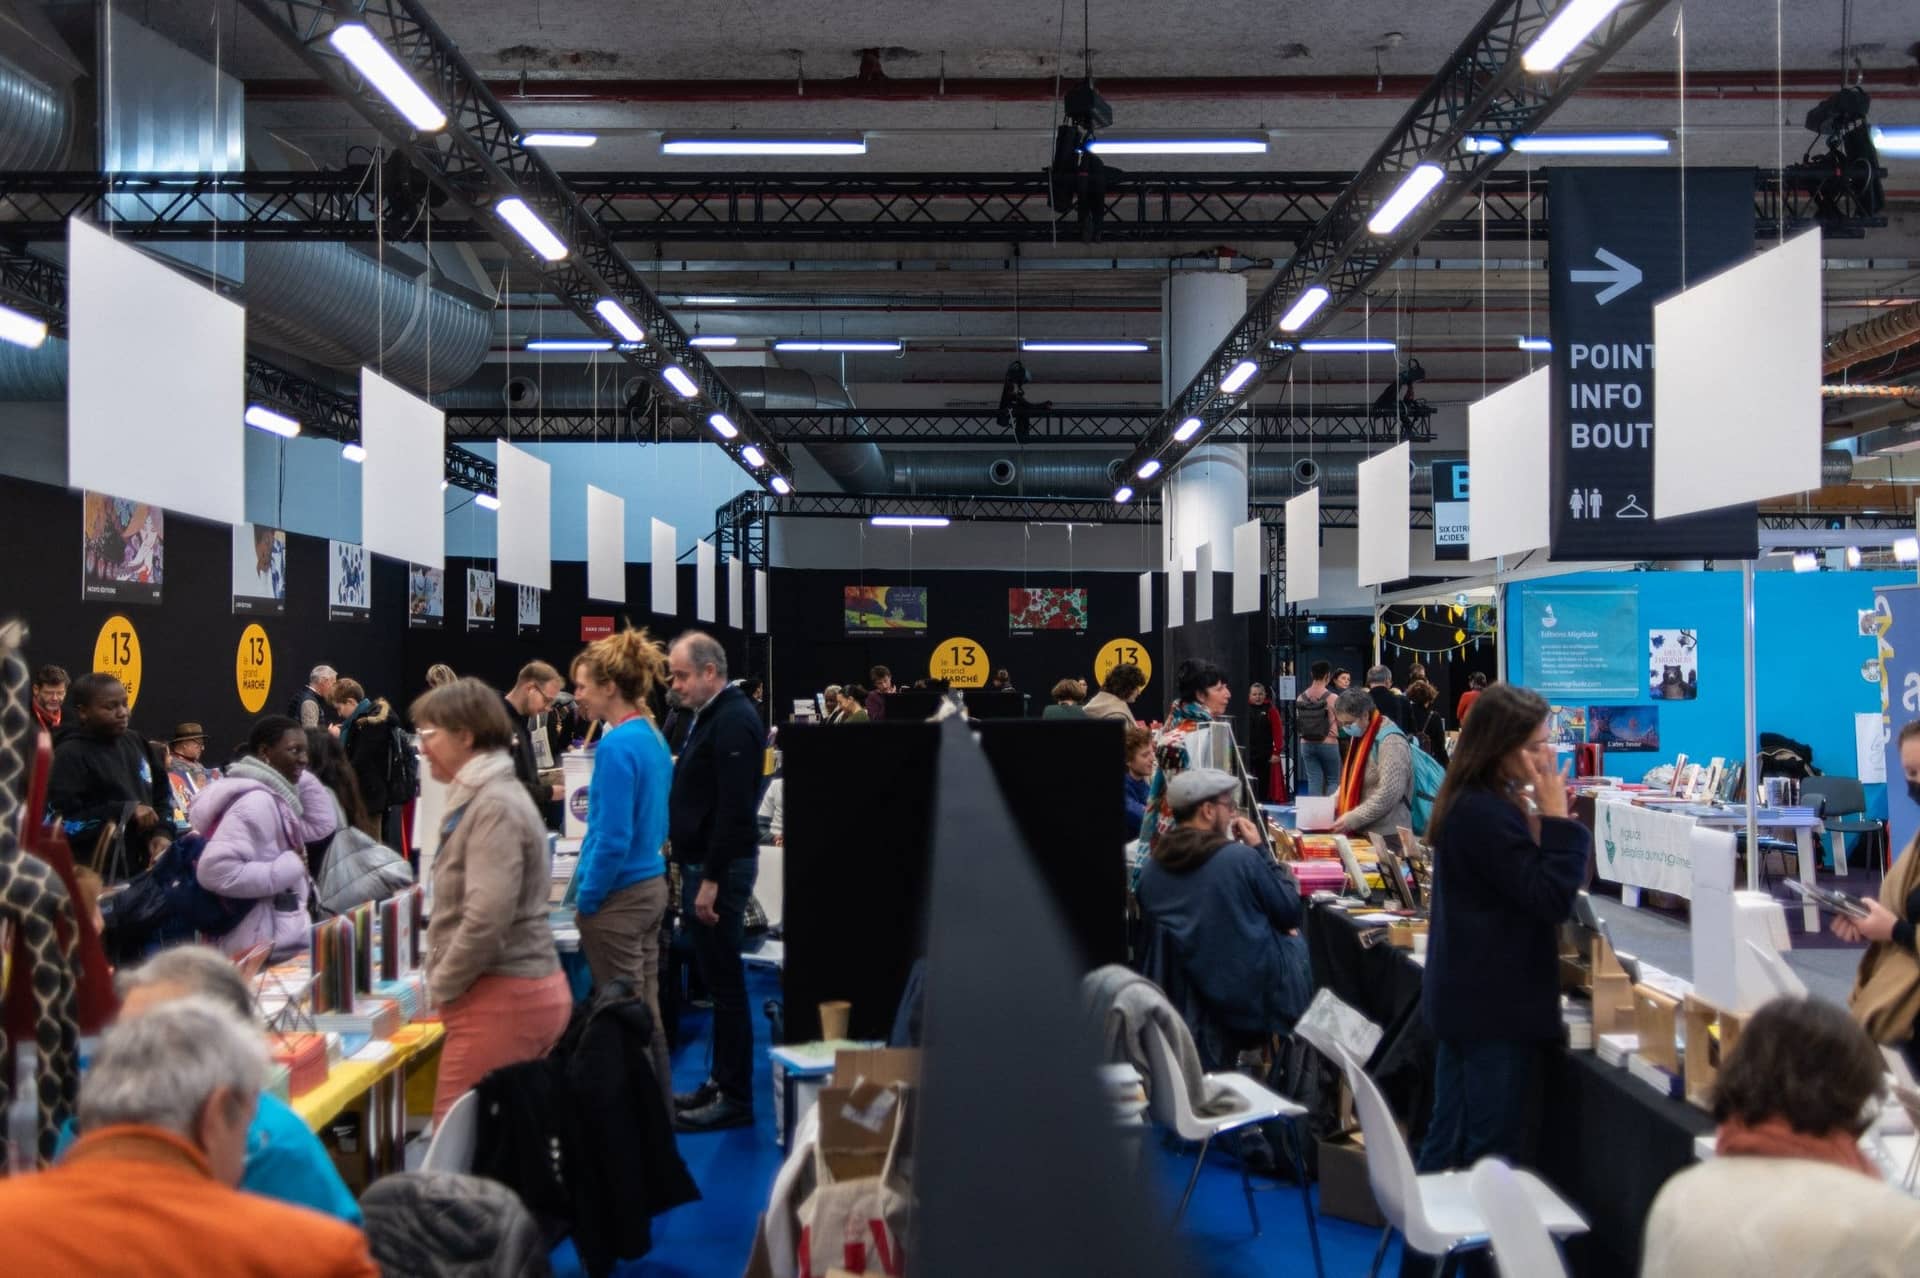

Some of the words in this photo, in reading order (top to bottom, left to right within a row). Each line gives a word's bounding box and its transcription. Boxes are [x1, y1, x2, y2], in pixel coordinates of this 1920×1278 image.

[1571, 344, 1656, 369] POINT
[1571, 384, 1642, 409] INFO
[1451, 525, 1469, 533] CITR
[111, 632, 131, 665] 13
[250, 637, 264, 666] 13
[951, 646, 975, 666] 13
[1115, 647, 1138, 665] 13
